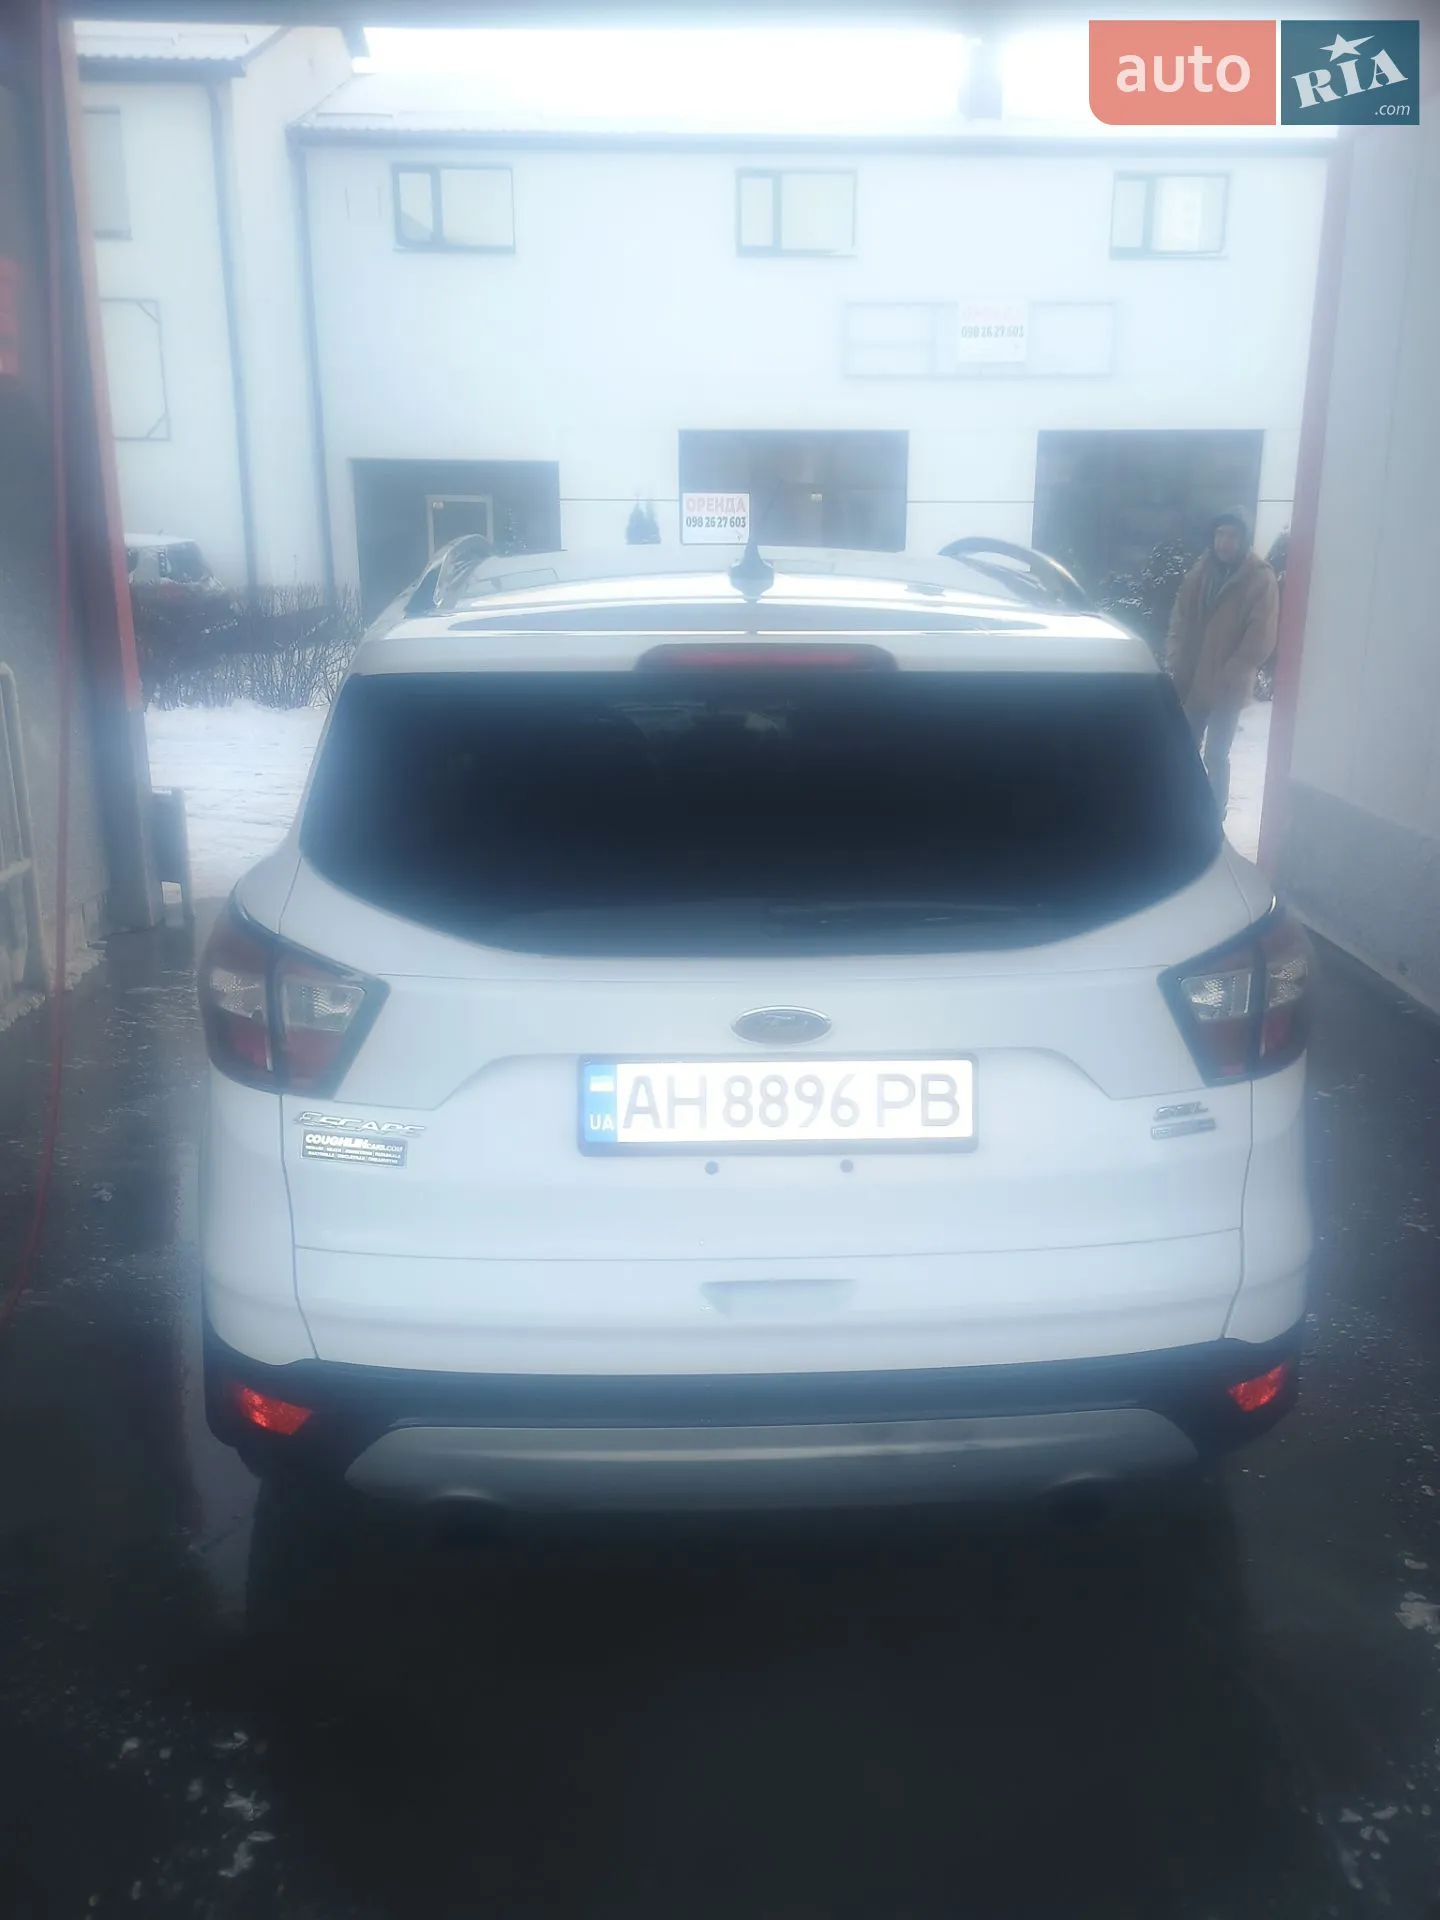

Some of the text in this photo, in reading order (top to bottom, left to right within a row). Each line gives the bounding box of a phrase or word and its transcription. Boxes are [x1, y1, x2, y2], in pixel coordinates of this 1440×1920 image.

[686, 497, 746, 513] ОРЕНДА
[686, 516, 746, 528] 098 26 27 603
[622, 1073, 961, 1130] AH 8896 PB
[294, 1111, 425, 1138] ESCAPE
[589, 1113, 615, 1132] UA
